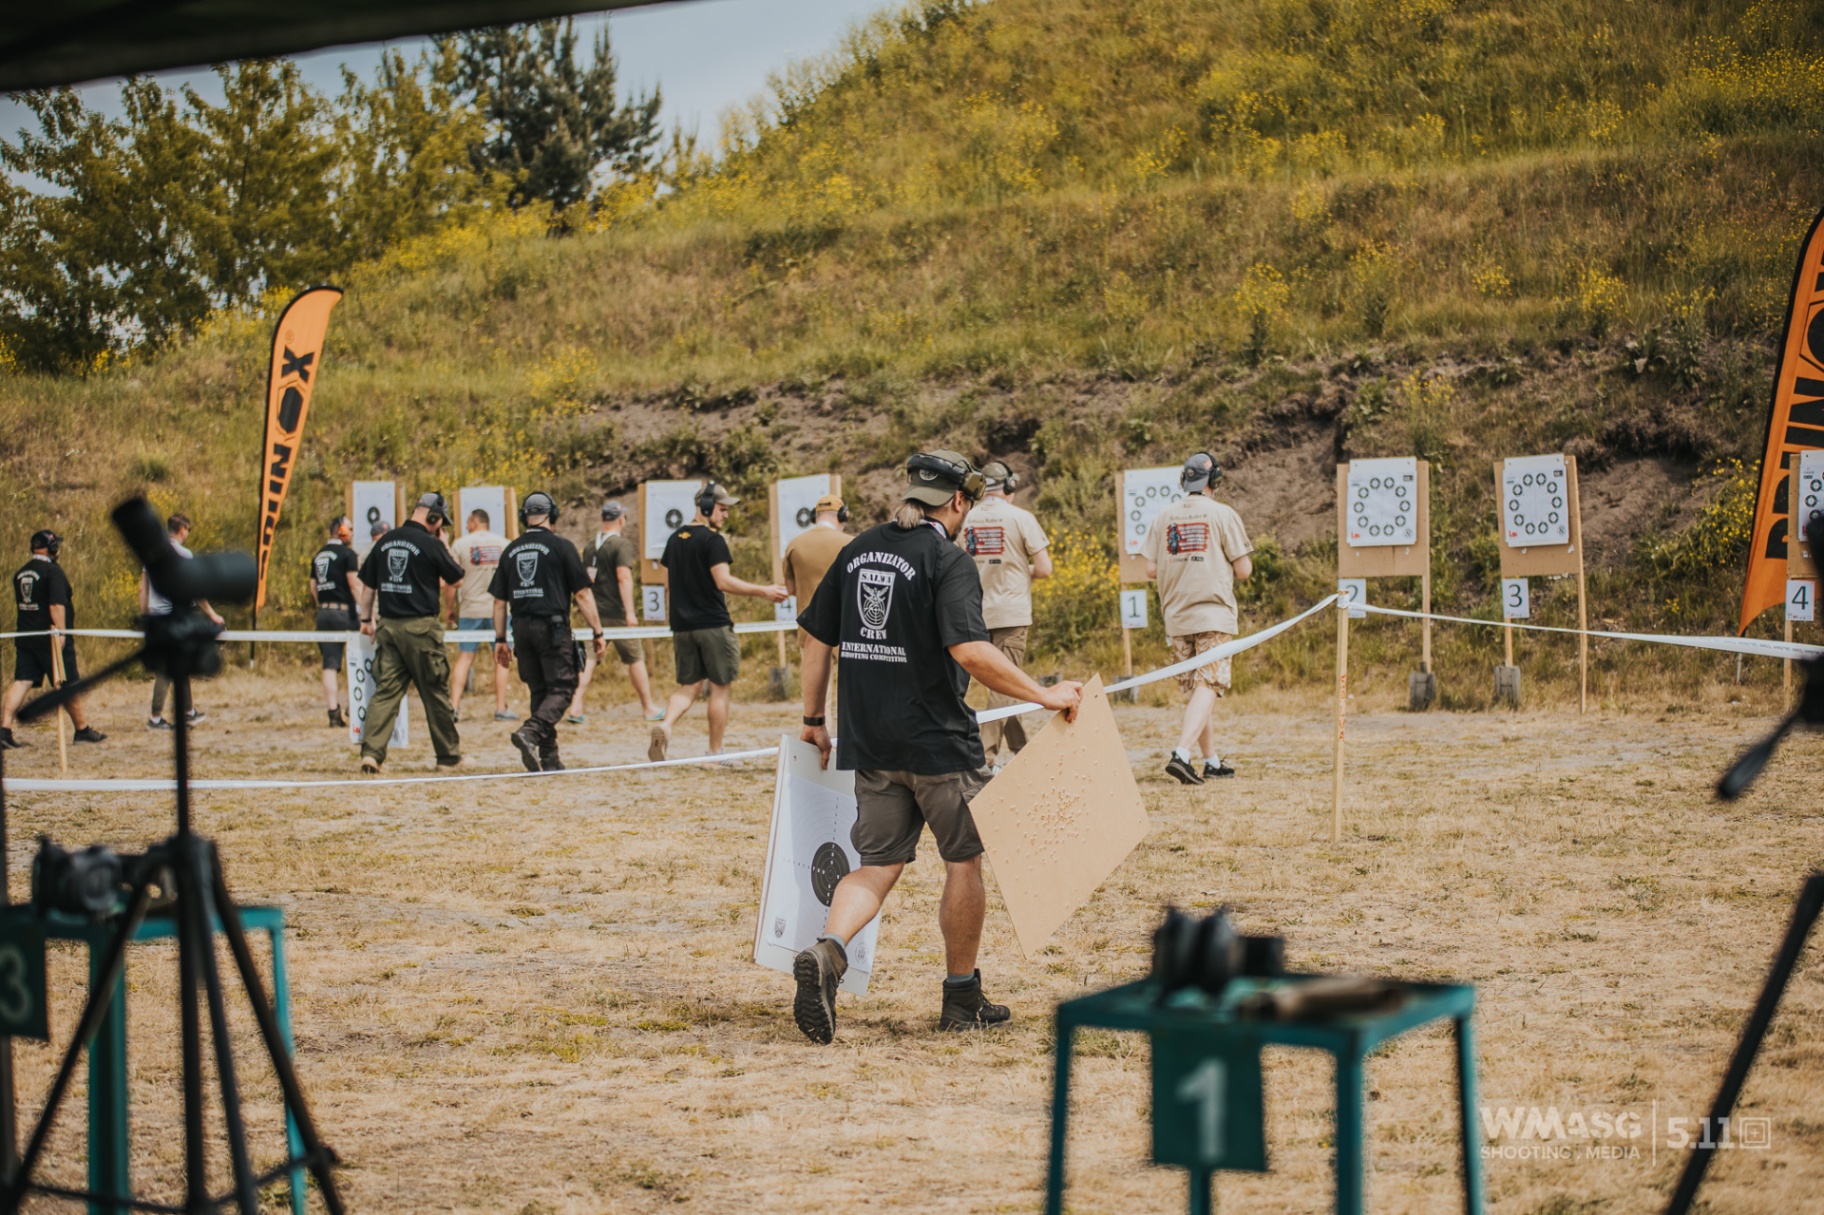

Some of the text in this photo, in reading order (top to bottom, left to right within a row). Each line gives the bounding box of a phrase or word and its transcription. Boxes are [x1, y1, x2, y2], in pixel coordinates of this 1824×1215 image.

[846, 551, 917, 581] ORGANIZATOR
[861, 573, 893, 584] SALWA
[648, 591, 660, 612] 3
[780, 595, 793, 613] 4
[1128, 595, 1141, 618] 1
[1508, 583, 1523, 607] 3
[1791, 585, 1809, 610] 4
[841, 641, 907, 656] INTERNATIONAL
[0, 945, 33, 1023] 3
[1176, 1056, 1226, 1162] 1
